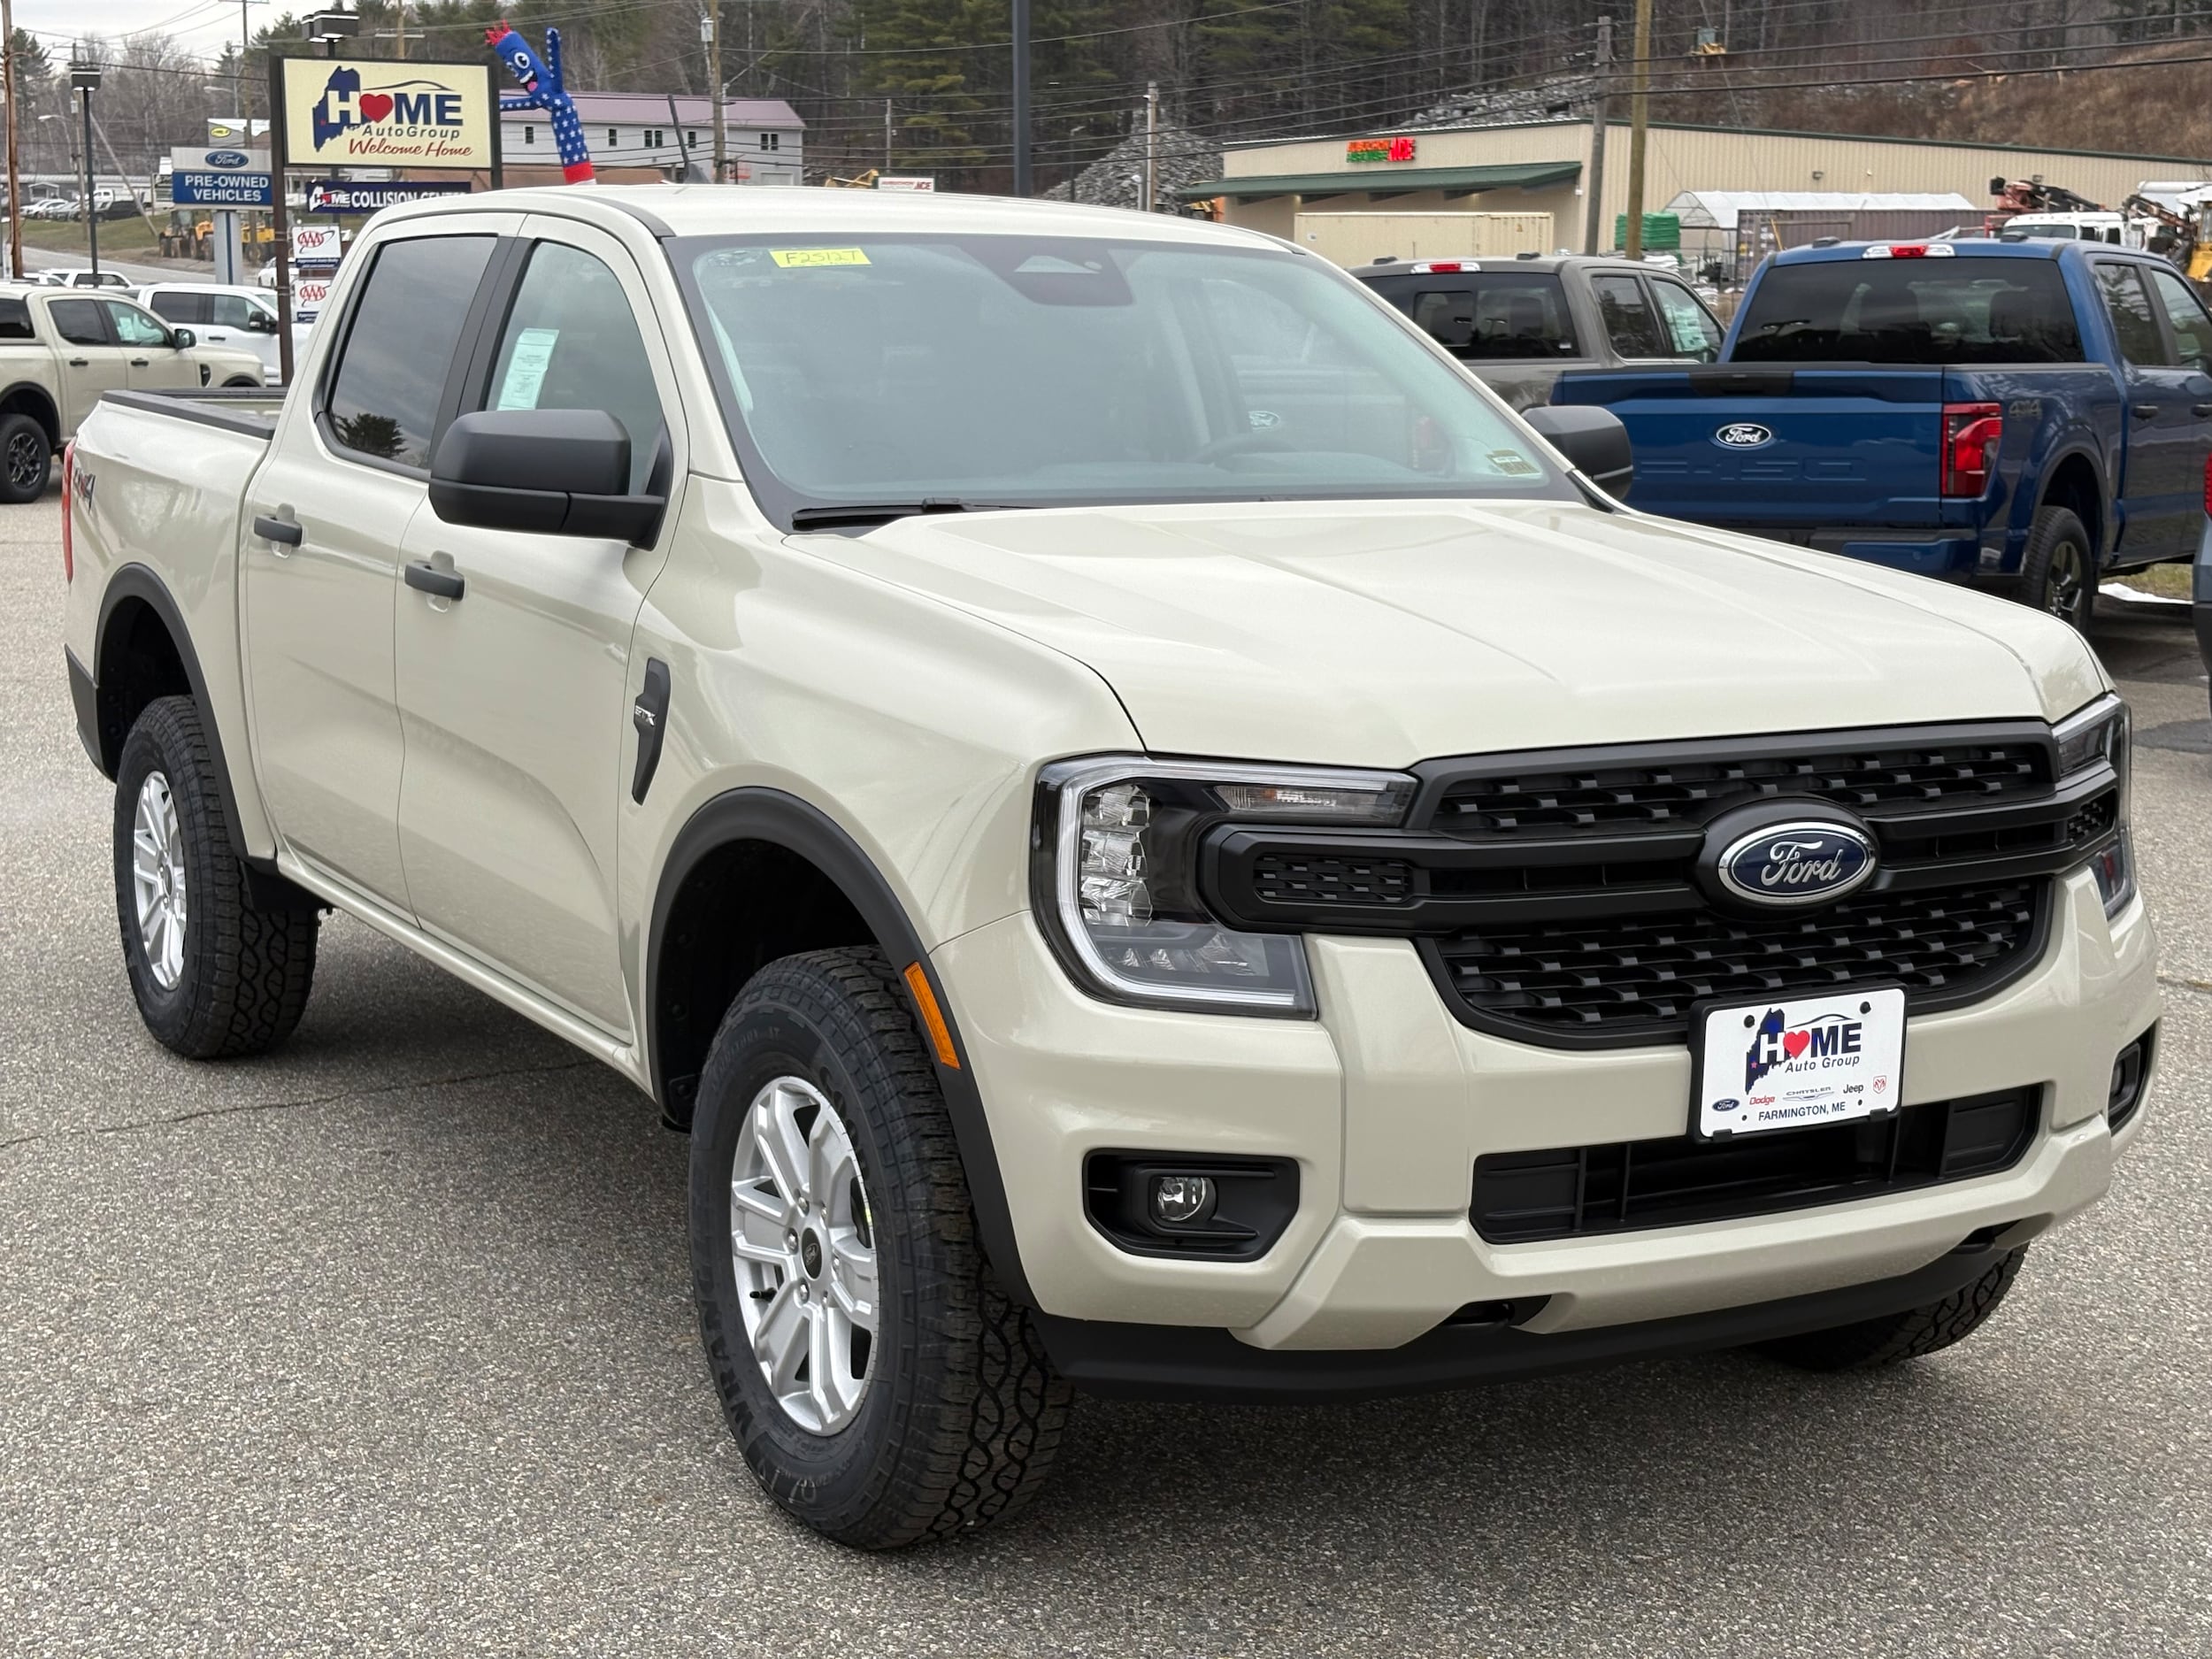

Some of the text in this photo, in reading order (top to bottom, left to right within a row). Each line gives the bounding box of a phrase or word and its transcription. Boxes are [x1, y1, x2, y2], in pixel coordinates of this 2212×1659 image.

[349, 138, 473, 157] Welcome Home
[184, 175, 269, 188] PRE-OWNED
[193, 188, 262, 202] VEHICLES
[299, 232, 323, 247] AAA
[301, 285, 326, 301] AAA
[1725, 426, 1762, 442] Ford
[1761, 841, 1843, 886] Ford
[1785, 1056, 1861, 1073] Auto Group
[1786, 1087, 1832, 1095] CHRYSLER
[1843, 1084, 1864, 1094] Jeep
[1749, 1095, 1776, 1105] Dodge
[1758, 1102, 1847, 1121] FARMINGTON, ME
